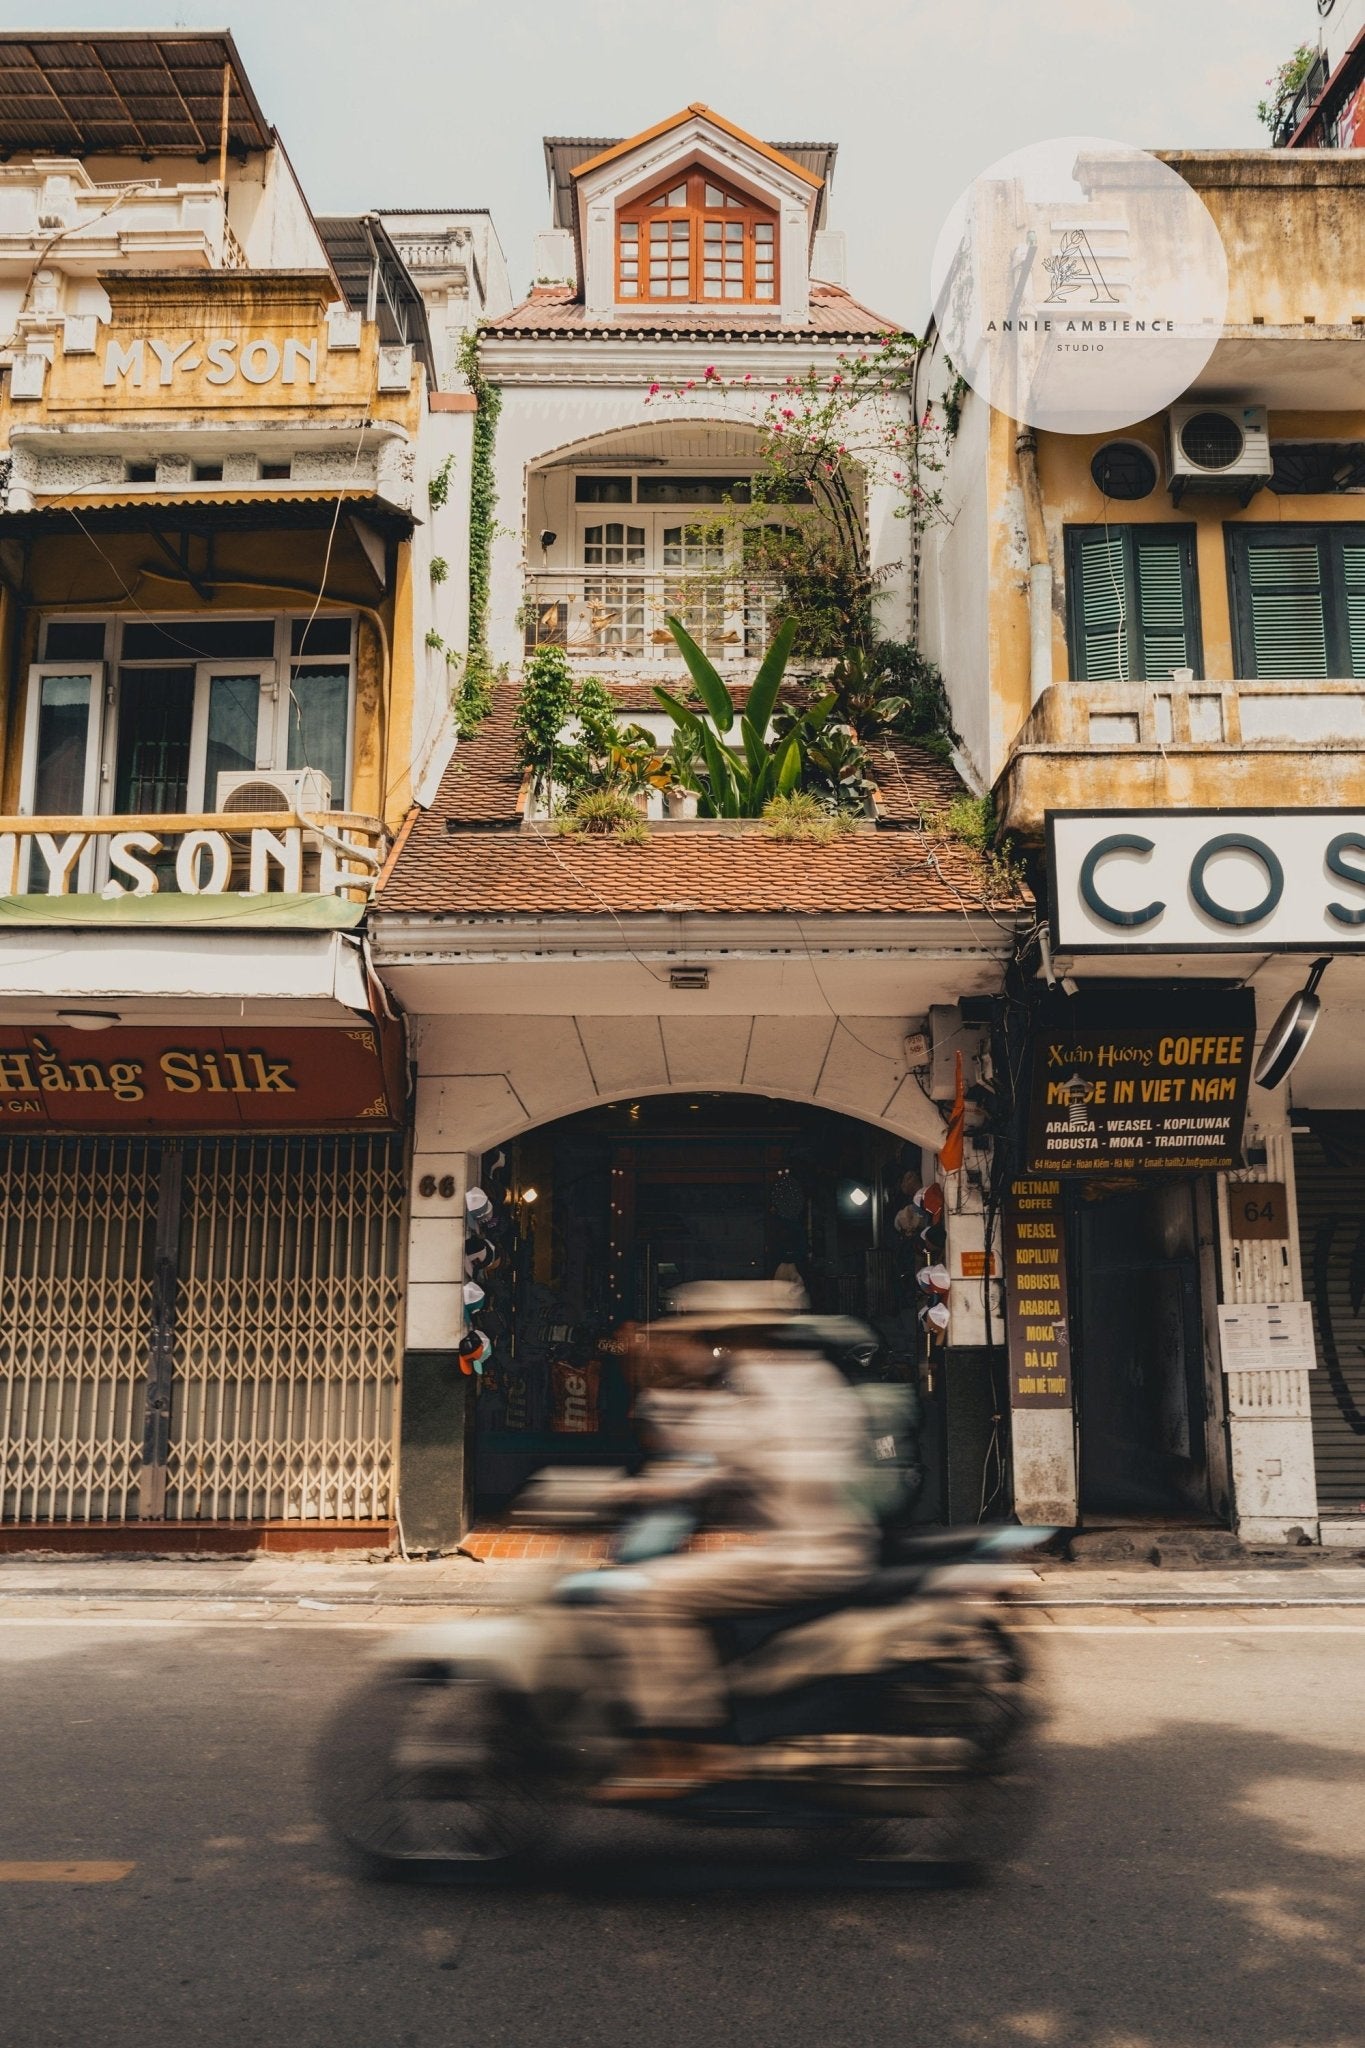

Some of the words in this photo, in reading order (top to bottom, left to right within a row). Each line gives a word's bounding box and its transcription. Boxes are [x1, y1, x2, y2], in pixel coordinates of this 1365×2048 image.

[103, 338, 318, 387] MY-SON
[0, 828, 303, 900] YSON
[1080, 832, 1365, 926] COS
[1048, 1045, 1094, 1068] Xuân
[1158, 1036, 1245, 1066] COFFEE
[0, 1038, 145, 1102] Hằng
[159, 1051, 296, 1094] Silk
[1114, 1080, 1135, 1104] IN
[1140, 1079, 1186, 1103] VIET
[1190, 1078, 1237, 1103] NAM
[8, 1100, 41, 1113] GAI
[1107, 1119, 1153, 1132] WEASEL
[1163, 1117, 1231, 1130] KOPILUWAK
[1047, 1138, 1098, 1150] ROBUSTA
[1109, 1136, 1144, 1149] MOKA
[1155, 1135, 1226, 1148] TRADITIONAL
[1034, 1159, 1043, 1169] 64
[1062, 1159, 1072, 1169] Gai
[418, 1174, 456, 1198] 66
[1011, 1180, 1060, 1195] VIETNAM
[1018, 1198, 1053, 1209] COFFEE
[1243, 1201, 1275, 1222] 64
[1017, 1223, 1057, 1239] WEASEL
[1016, 1248, 1059, 1264] KOPILUW
[1017, 1274, 1061, 1290] ROBUSTA
[1019, 1300, 1061, 1316] ARABICA
[1026, 1326, 1055, 1342] MOKA
[1024, 1348, 1039, 1367] ĐÀ
[1041, 1351, 1058, 1371] LẠT
